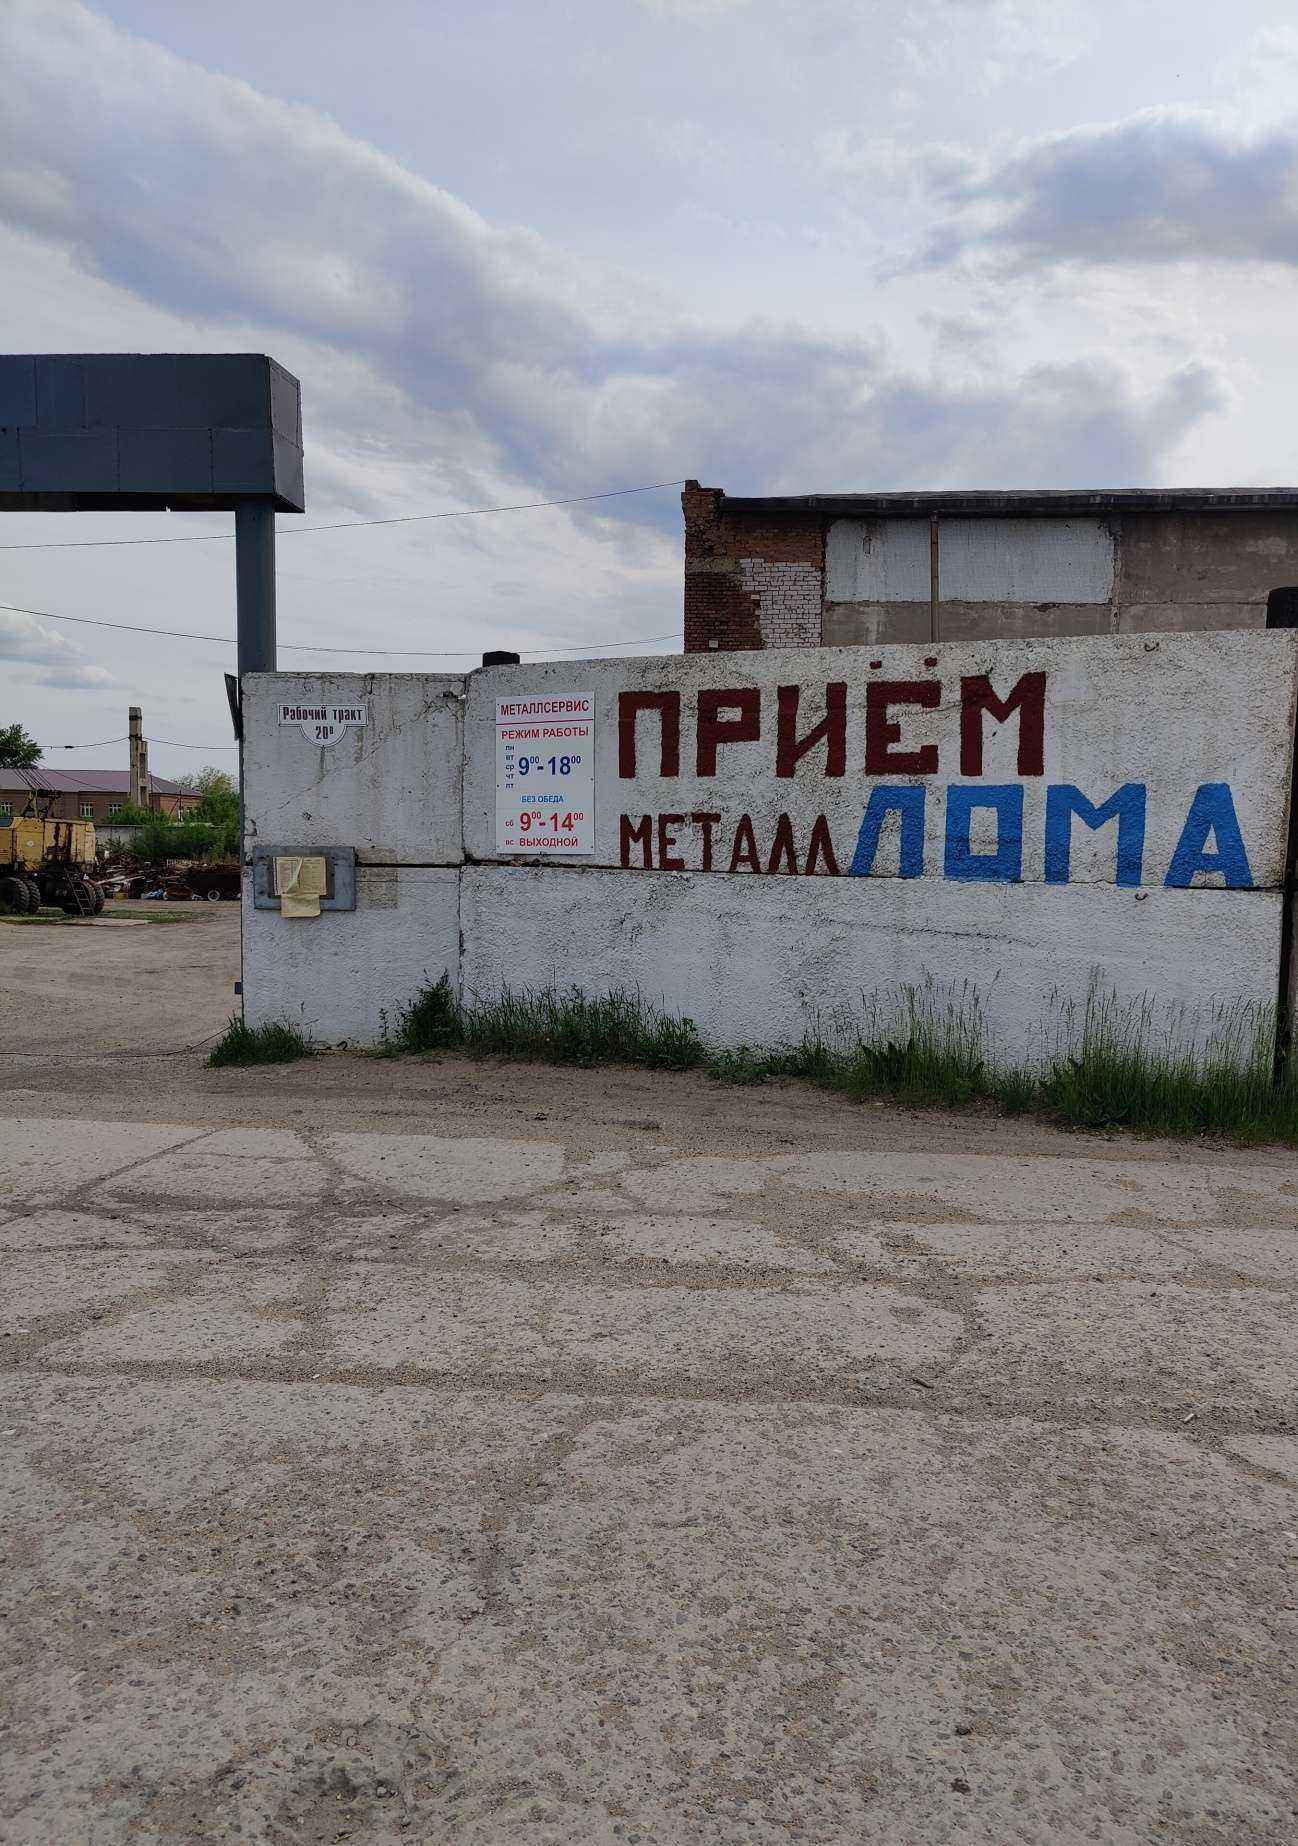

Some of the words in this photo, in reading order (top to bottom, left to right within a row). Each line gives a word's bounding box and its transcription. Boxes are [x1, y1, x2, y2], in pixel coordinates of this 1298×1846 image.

[283, 706, 327, 720] Рабочий
[333, 709, 362, 723] тракт
[500, 700, 590, 716] МЕТАЛЛСЕРВИС
[618, 657, 1046, 778] ПРИЁМ
[501, 729, 540, 740] РЕЖИМ
[542, 726, 589, 738] РАБОТЫ
[537, 795, 565, 803] ОБЕДА
[519, 837, 578, 847] ВЫХОДНОЙ
